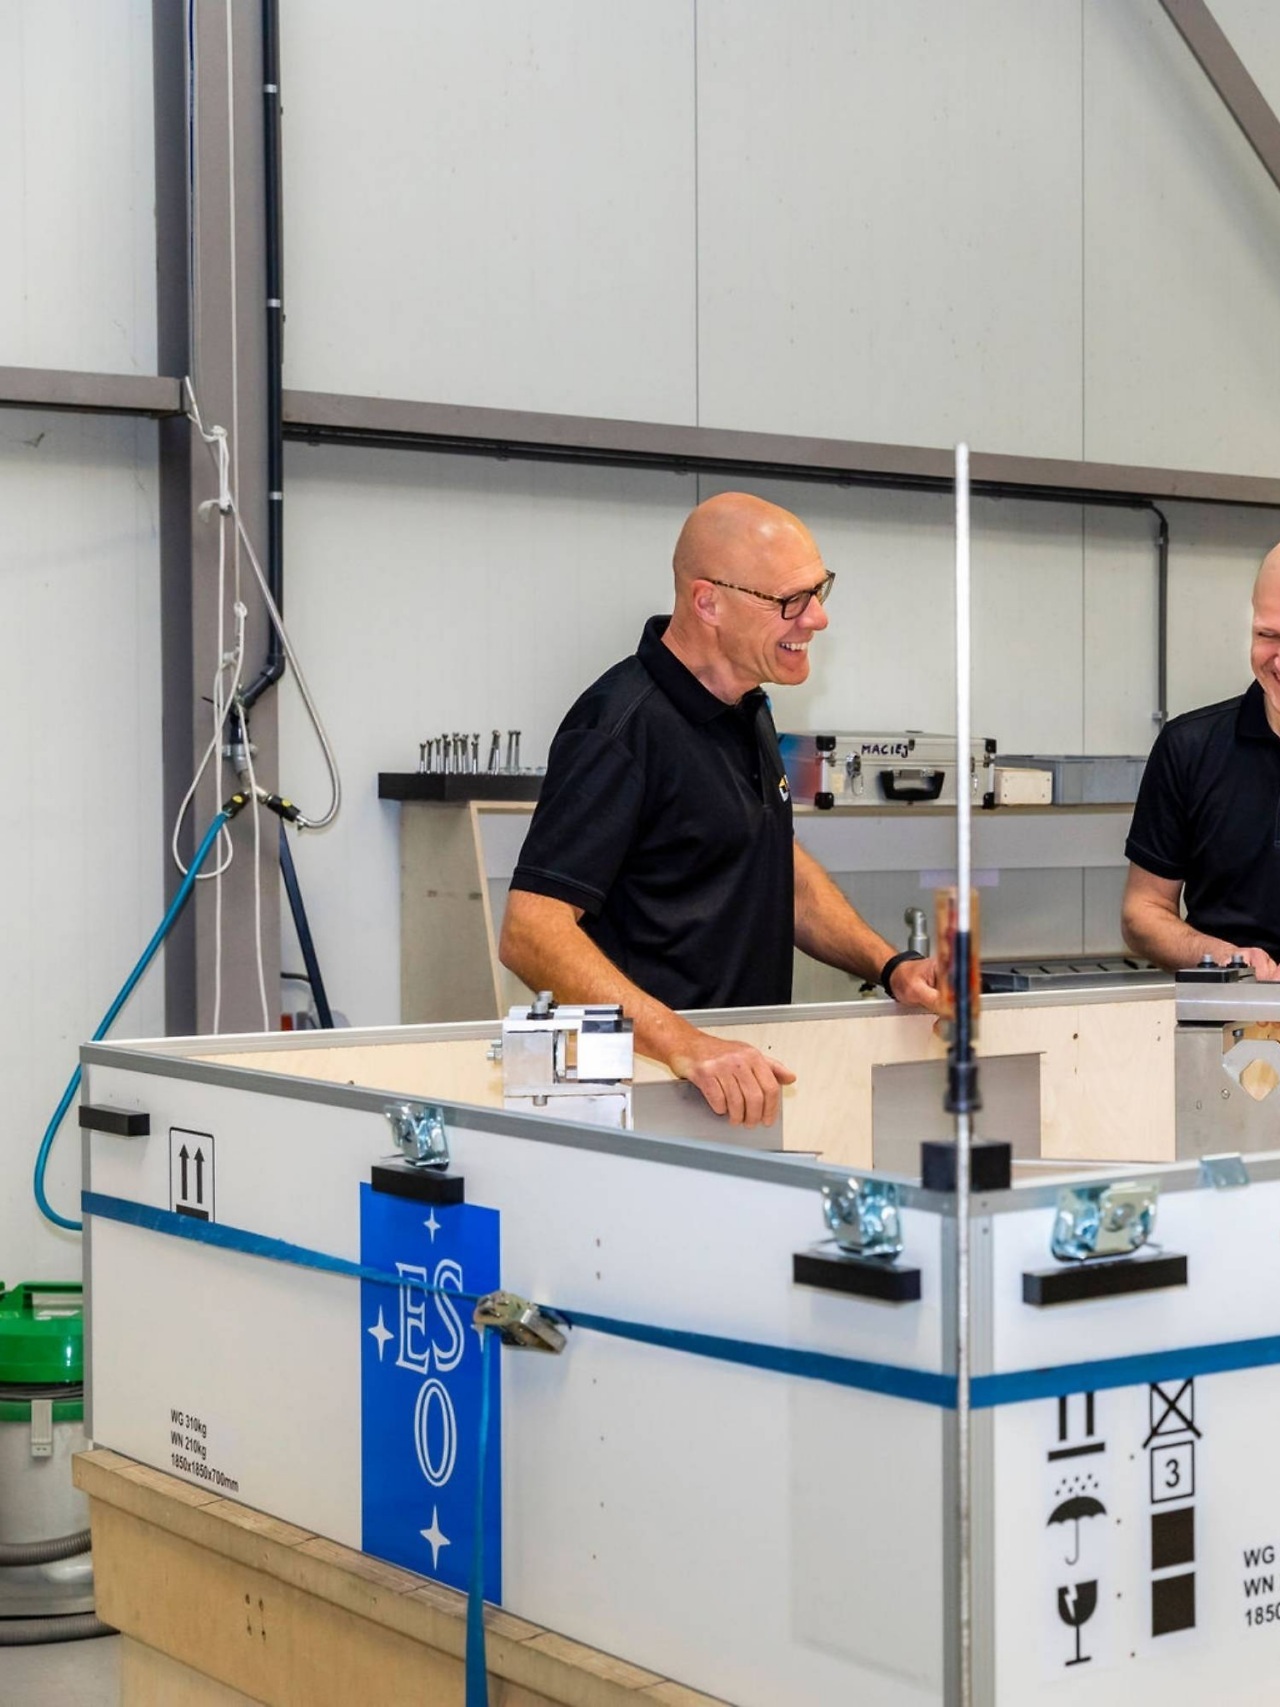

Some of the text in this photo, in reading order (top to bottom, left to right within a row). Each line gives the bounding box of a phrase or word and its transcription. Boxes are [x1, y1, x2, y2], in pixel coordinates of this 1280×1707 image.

[861, 743, 908, 758] MACIEJ
[170, 1409, 207, 1439] WG 310kg
[170, 1430, 207, 1461] WN 210kg
[171, 1452, 239, 1492] 1850x1850x700mm
[1166, 1458, 1180, 1488] 3
[1243, 1545, 1275, 1569] WG
[1243, 1574, 1274, 1598] WN
